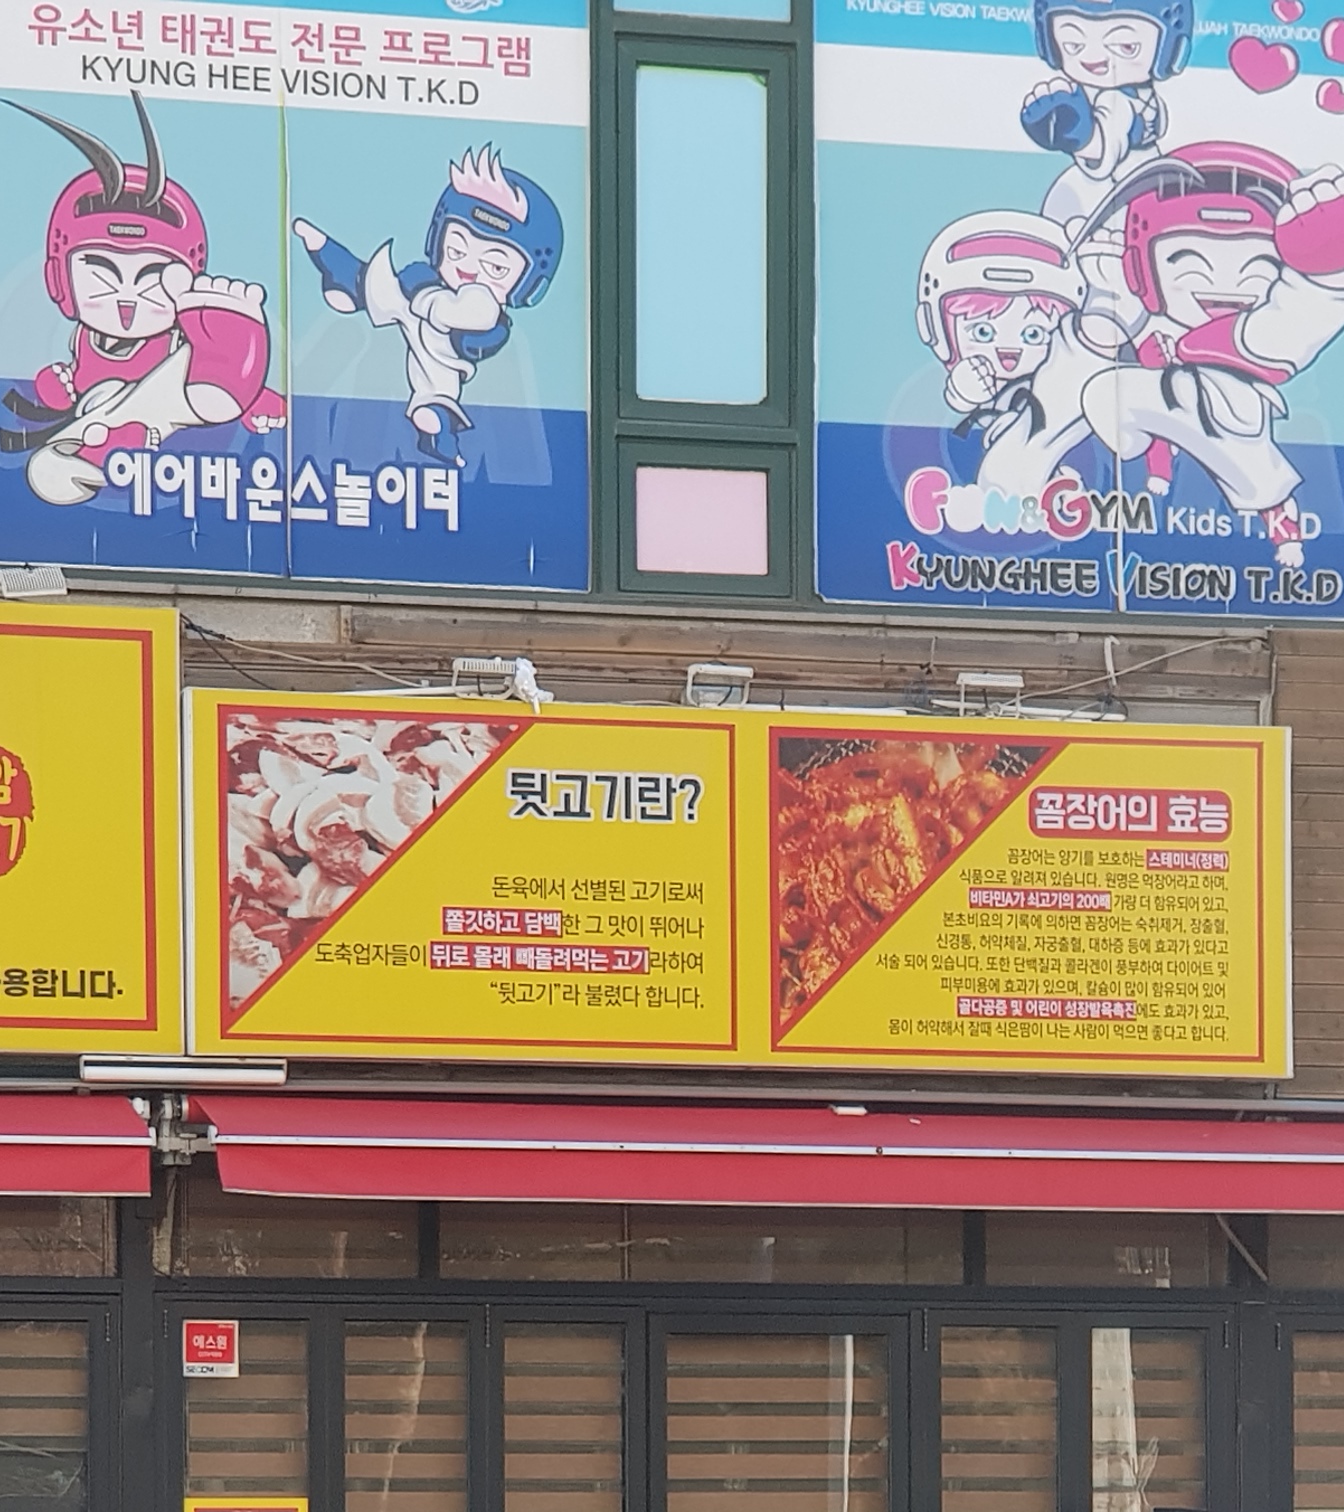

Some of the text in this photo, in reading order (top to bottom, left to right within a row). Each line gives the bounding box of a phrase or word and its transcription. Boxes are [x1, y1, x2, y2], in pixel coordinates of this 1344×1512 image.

[27, 3, 532, 78] 유소년 태권도 전문 프로그램
[80, 54, 480, 107] KYUNG HEE VISION T.K.D
[107, 449, 460, 532] 에어바운스놀이터
[1166, 509, 1234, 538] Kids
[1238, 510, 1323, 543] T.K.D
[886, 541, 1343, 604] KYUNGHEE VISION T.K.D
[508, 769, 703, 823] 뒷고기란?
[1033, 791, 1230, 836] 꼼장어의 효능
[1007, 848, 1056, 866] 꼼장어는
[1097, 850, 1145, 868] 보호하는
[492, 876, 704, 905] 돈육에서 선별된 고기로써
[959, 868, 1007, 885] 식품으로
[1011, 870, 1047, 886] 알려져
[1050, 871, 1101, 888] 있습니다.
[1105, 872, 1140, 889] 원명은
[1027, 891, 1075, 910] 쇠고기의
[444, 909, 521, 934] 쫄깃하고
[584, 915, 604, 934] 그
[608, 915, 644, 937] 맛이
[650, 916, 704, 939] 뛰어나
[315, 942, 427, 966] 도축업자들이
[432, 945, 470, 968] 뒤로
[474, 946, 511, 969] 몰래
[1154, 939, 1229, 956] 효과가 있다고
[1166, 960, 1214, 977] 다이어트
[585, 984, 640, 1007] 불렸다
[646, 985, 704, 1009] 합니다.
[940, 976, 1001, 994] 피부미용에
[1046, 1022, 1229, 1042] 나는 사람이 합니다.
